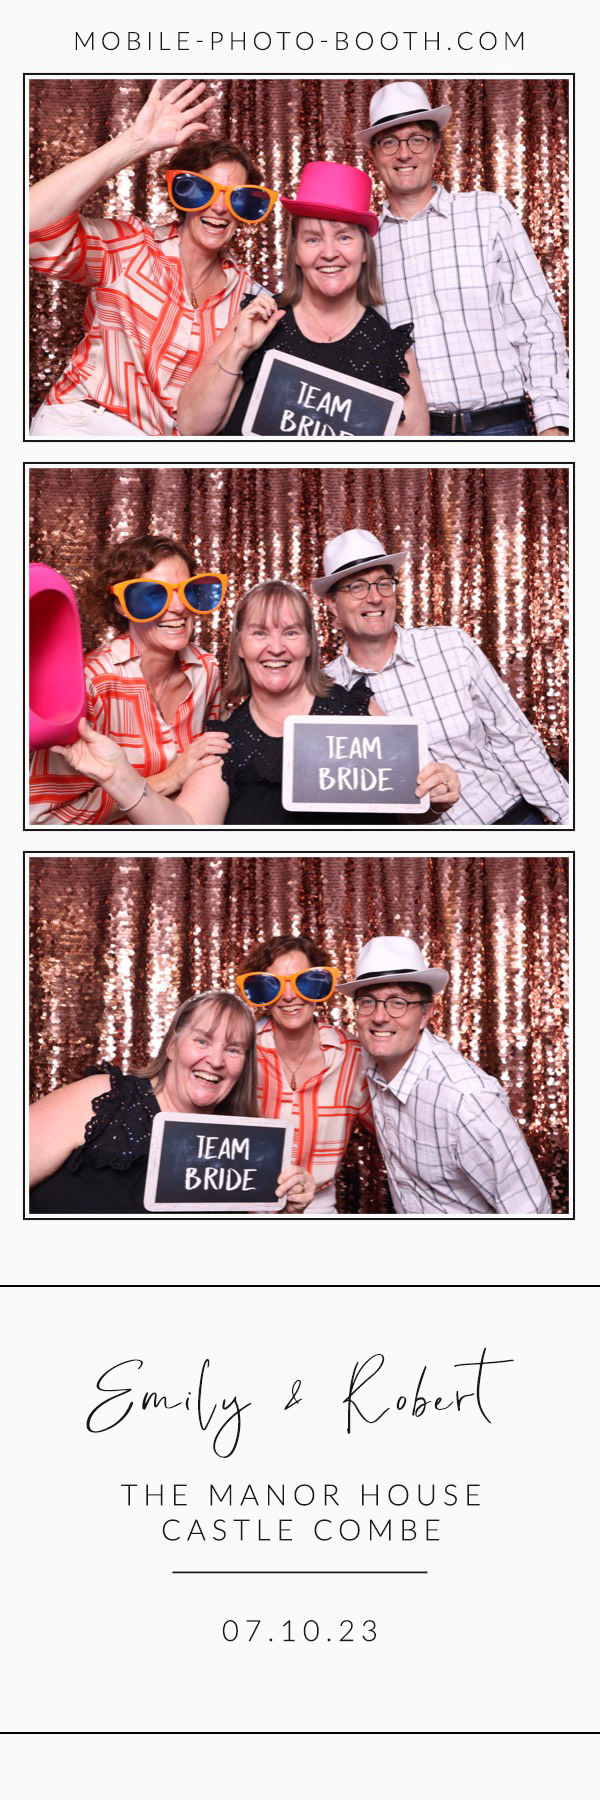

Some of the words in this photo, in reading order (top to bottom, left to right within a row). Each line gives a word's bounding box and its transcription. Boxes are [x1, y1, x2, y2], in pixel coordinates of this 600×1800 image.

[297, 381, 352, 422] TEAM
[280, 409, 354, 436] BRID
[326, 735, 382, 760] TEAM
[319, 767, 394, 791] BRIDE
[197, 1135, 250, 1160] TEAM
[185, 1167, 257, 1191] BRIDE
